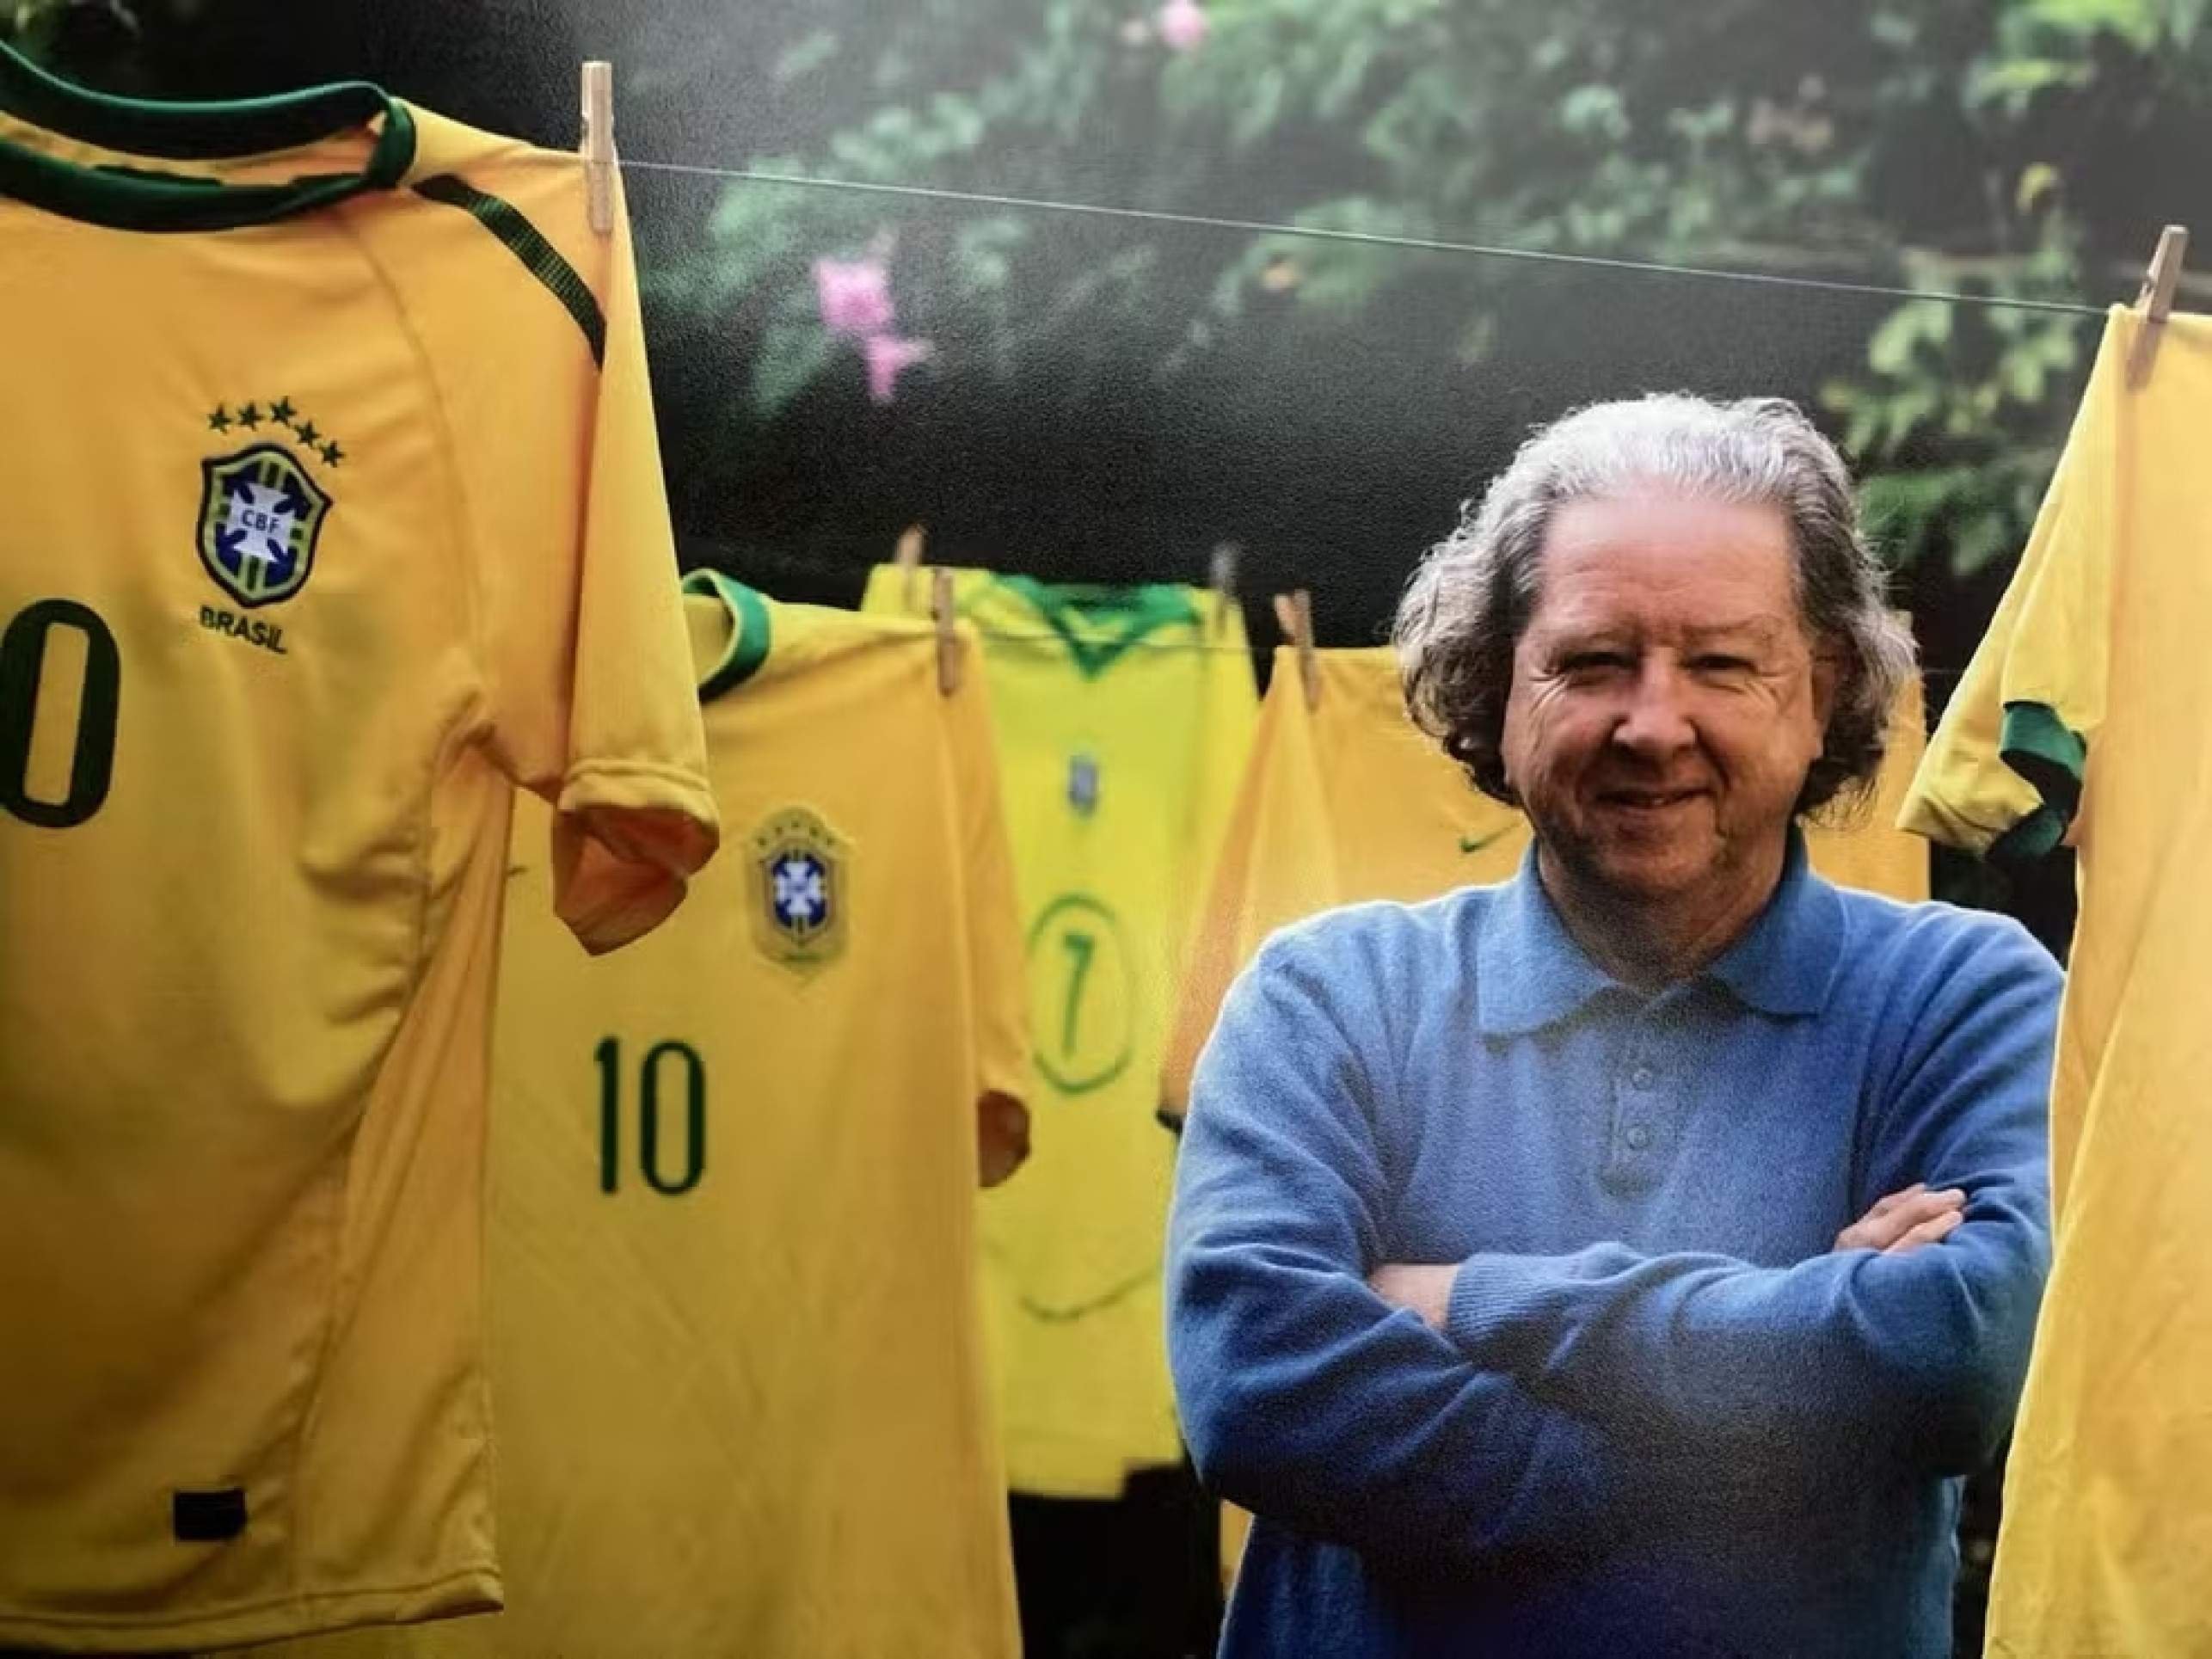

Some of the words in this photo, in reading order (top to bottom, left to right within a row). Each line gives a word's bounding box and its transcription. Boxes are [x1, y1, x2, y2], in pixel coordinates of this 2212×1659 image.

[242, 509, 280, 533] CBF
[200, 605, 286, 654] BRASIL
[593, 1035, 705, 1195] 10
